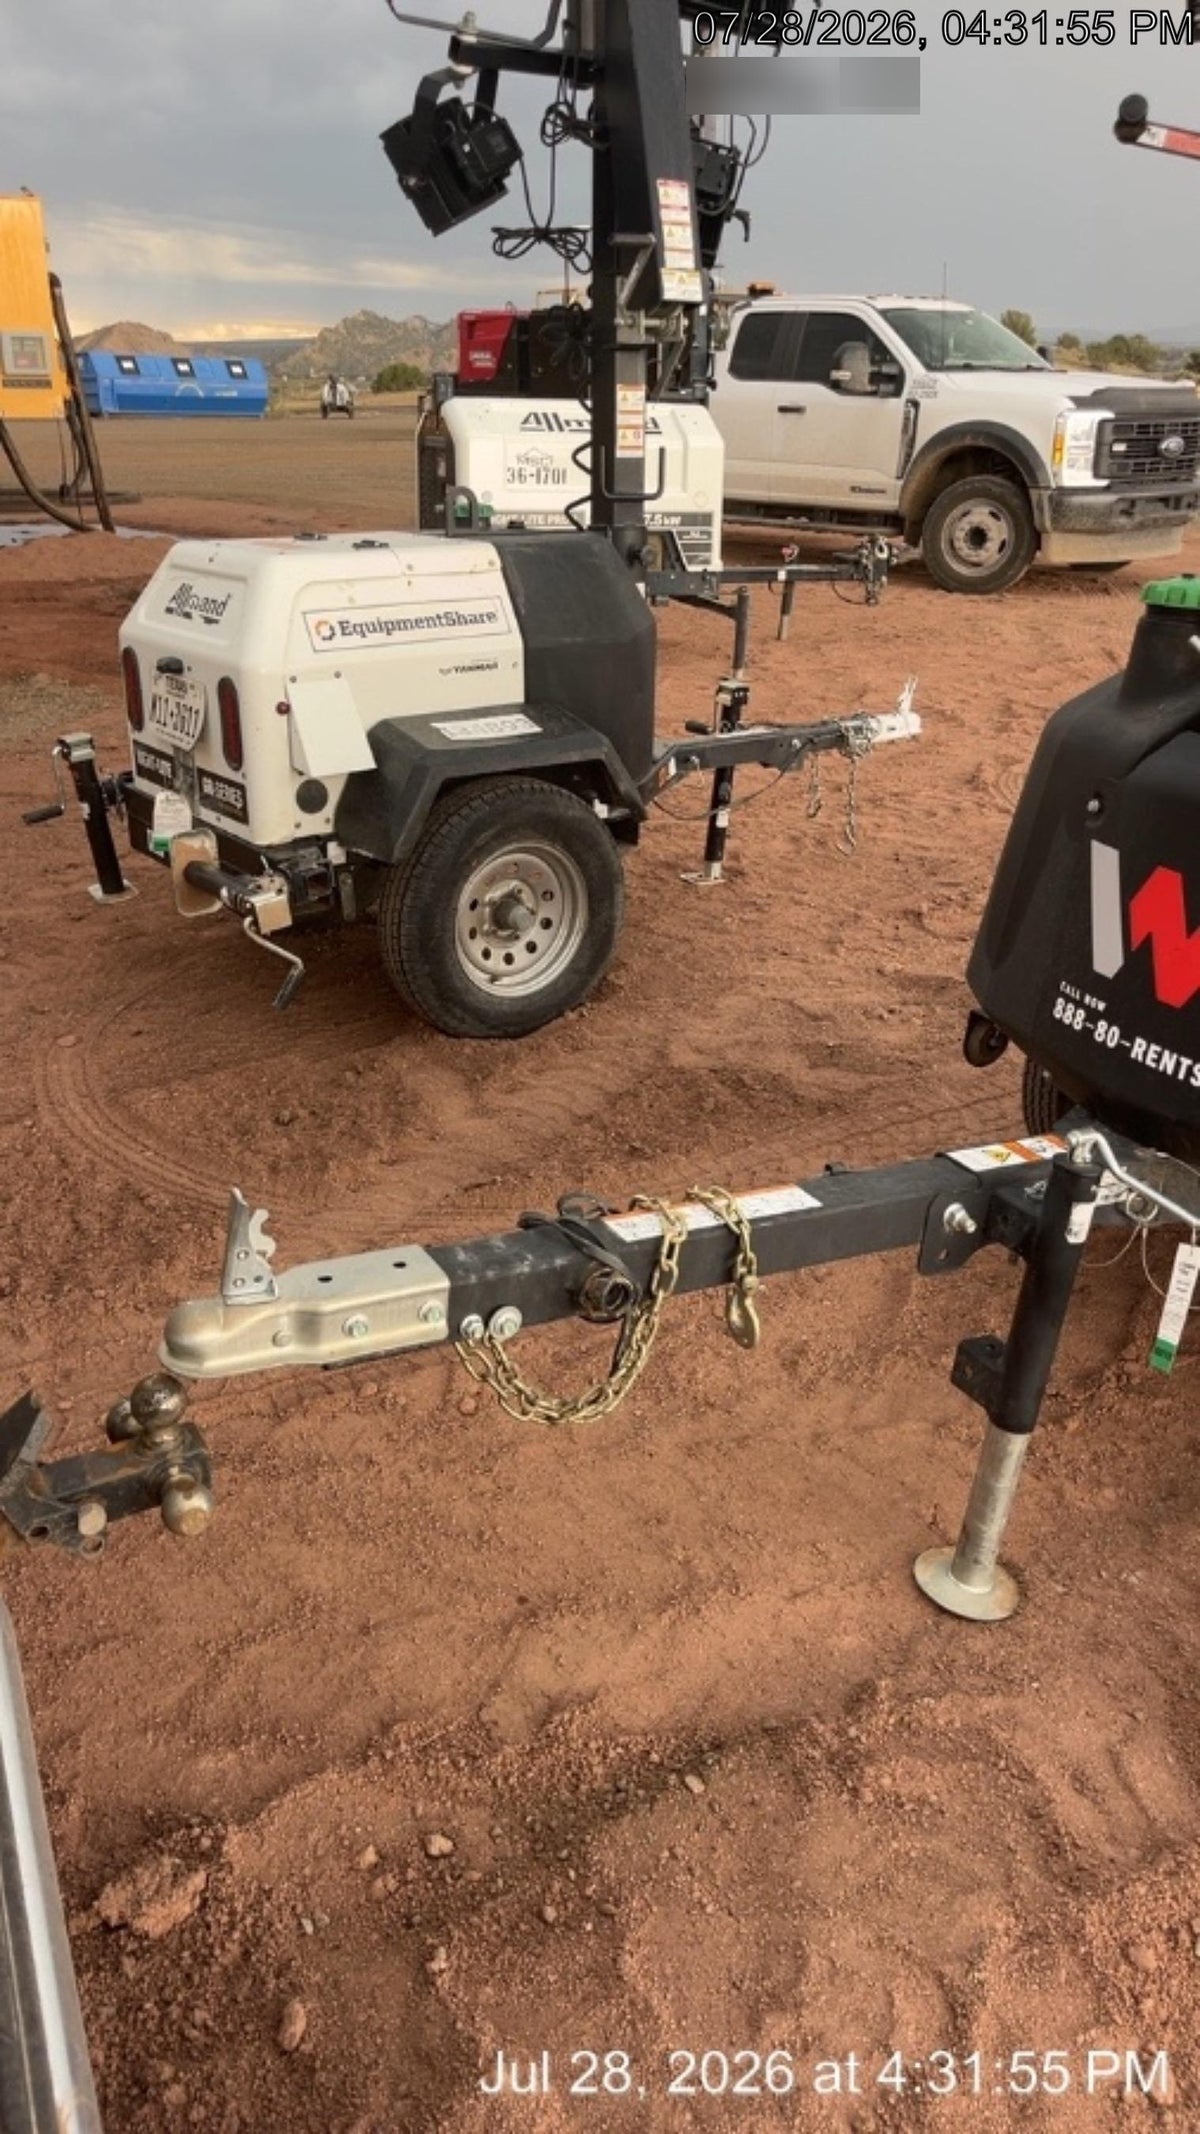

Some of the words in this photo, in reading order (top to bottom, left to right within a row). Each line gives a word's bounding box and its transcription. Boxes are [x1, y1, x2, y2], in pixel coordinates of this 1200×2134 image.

[338, 610, 498, 639] EquipmentShare
[1059, 980, 1081, 1001] CALL
[1083, 992, 1108, 1013] NOW
